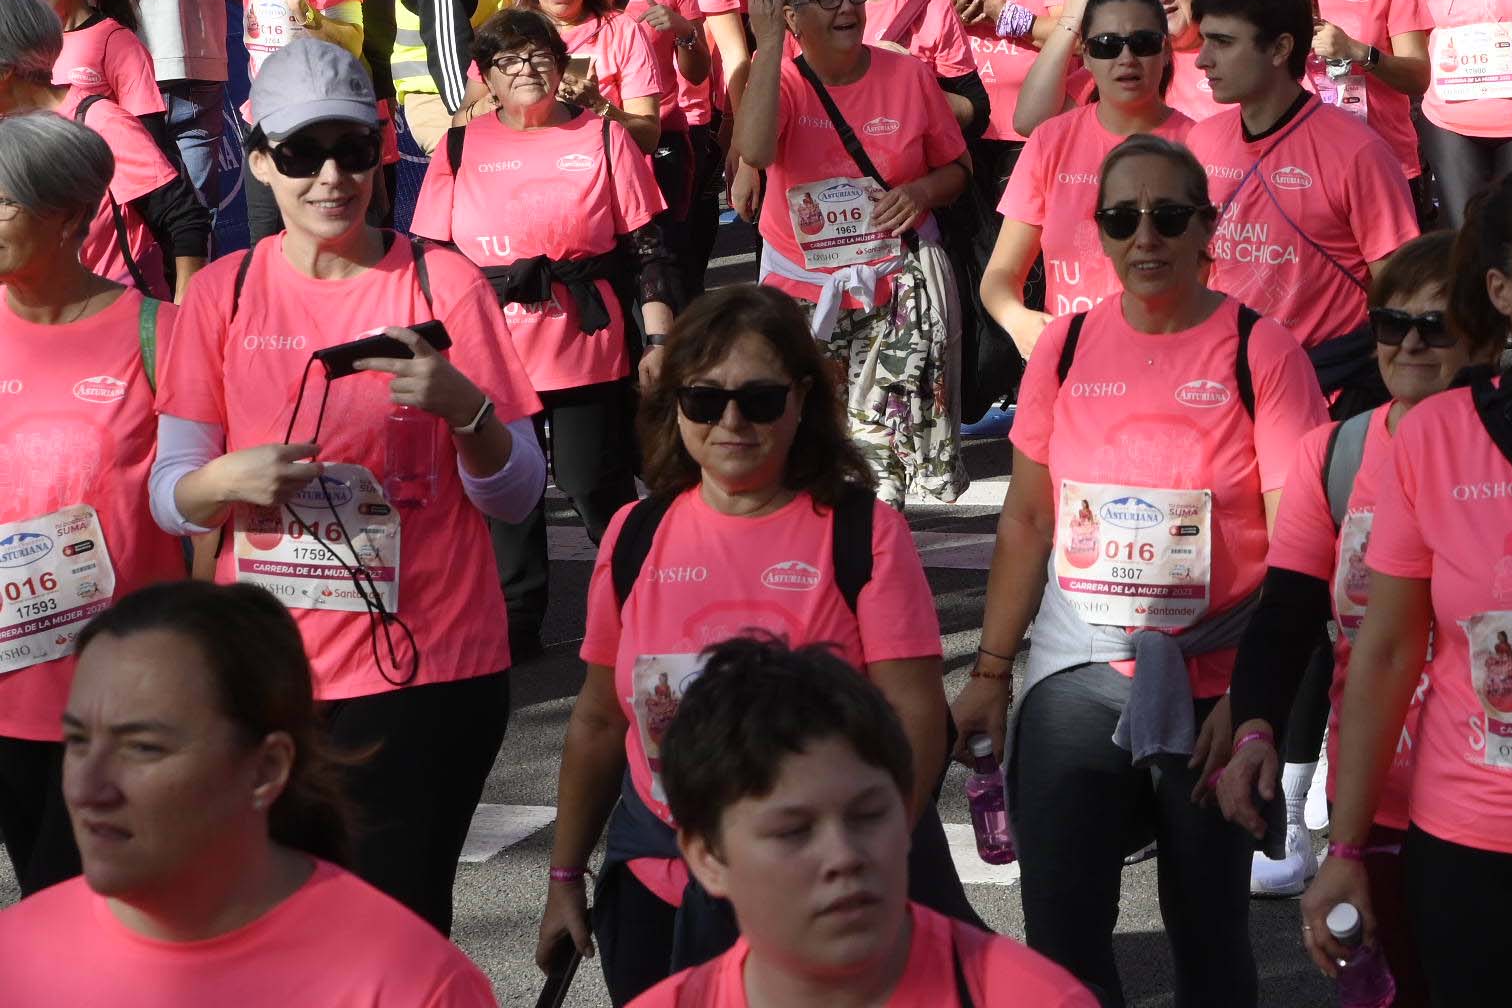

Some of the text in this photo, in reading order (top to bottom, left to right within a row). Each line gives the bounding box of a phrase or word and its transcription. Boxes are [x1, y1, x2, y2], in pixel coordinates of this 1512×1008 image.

[1461, 53, 1488, 65] 016
[478, 159, 522, 173] OYSHO
[1205, 164, 1243, 180] OYSHO
[820, 190, 860, 200] ASTURIANA
[826, 207, 862, 224] 016
[835, 225, 857, 235] 1963
[477, 235, 512, 257] TU
[810, 239, 836, 249] CARRERA
[855, 234, 876, 243] MUJER
[1050, 259, 1080, 285] TU
[243, 336, 307, 351] OYSHO
[1071, 382, 1126, 398] OYSHO
[1180, 390, 1228, 403] ASTURIANA
[1103, 507, 1160, 524] ASTURIANA
[1169, 508, 1199, 518] SUMA
[57, 522, 87, 537] SUMA
[288, 520, 342, 542] 016
[293, 547, 335, 561] 17592
[1105, 540, 1155, 562] 016
[254, 563, 294, 575] CARRERA
[296, 567, 308, 575] DE
[310, 567, 322, 576] LA
[1111, 567, 1143, 580] 8307
[5, 571, 57, 601] 016
[766, 573, 820, 585] ASTURIANA
[1069, 581, 1110, 592] CARRERA
[1111, 584, 1123, 593] DE
[1124, 585, 1137, 594] LA
[1137, 586, 1169, 596] MUJER
[17, 598, 58, 619] 17593
[1147, 605, 1196, 617] Santander
[24, 624, 36, 633] DE
[38, 620, 50, 629] LA
[53, 611, 83, 626] MUJER
